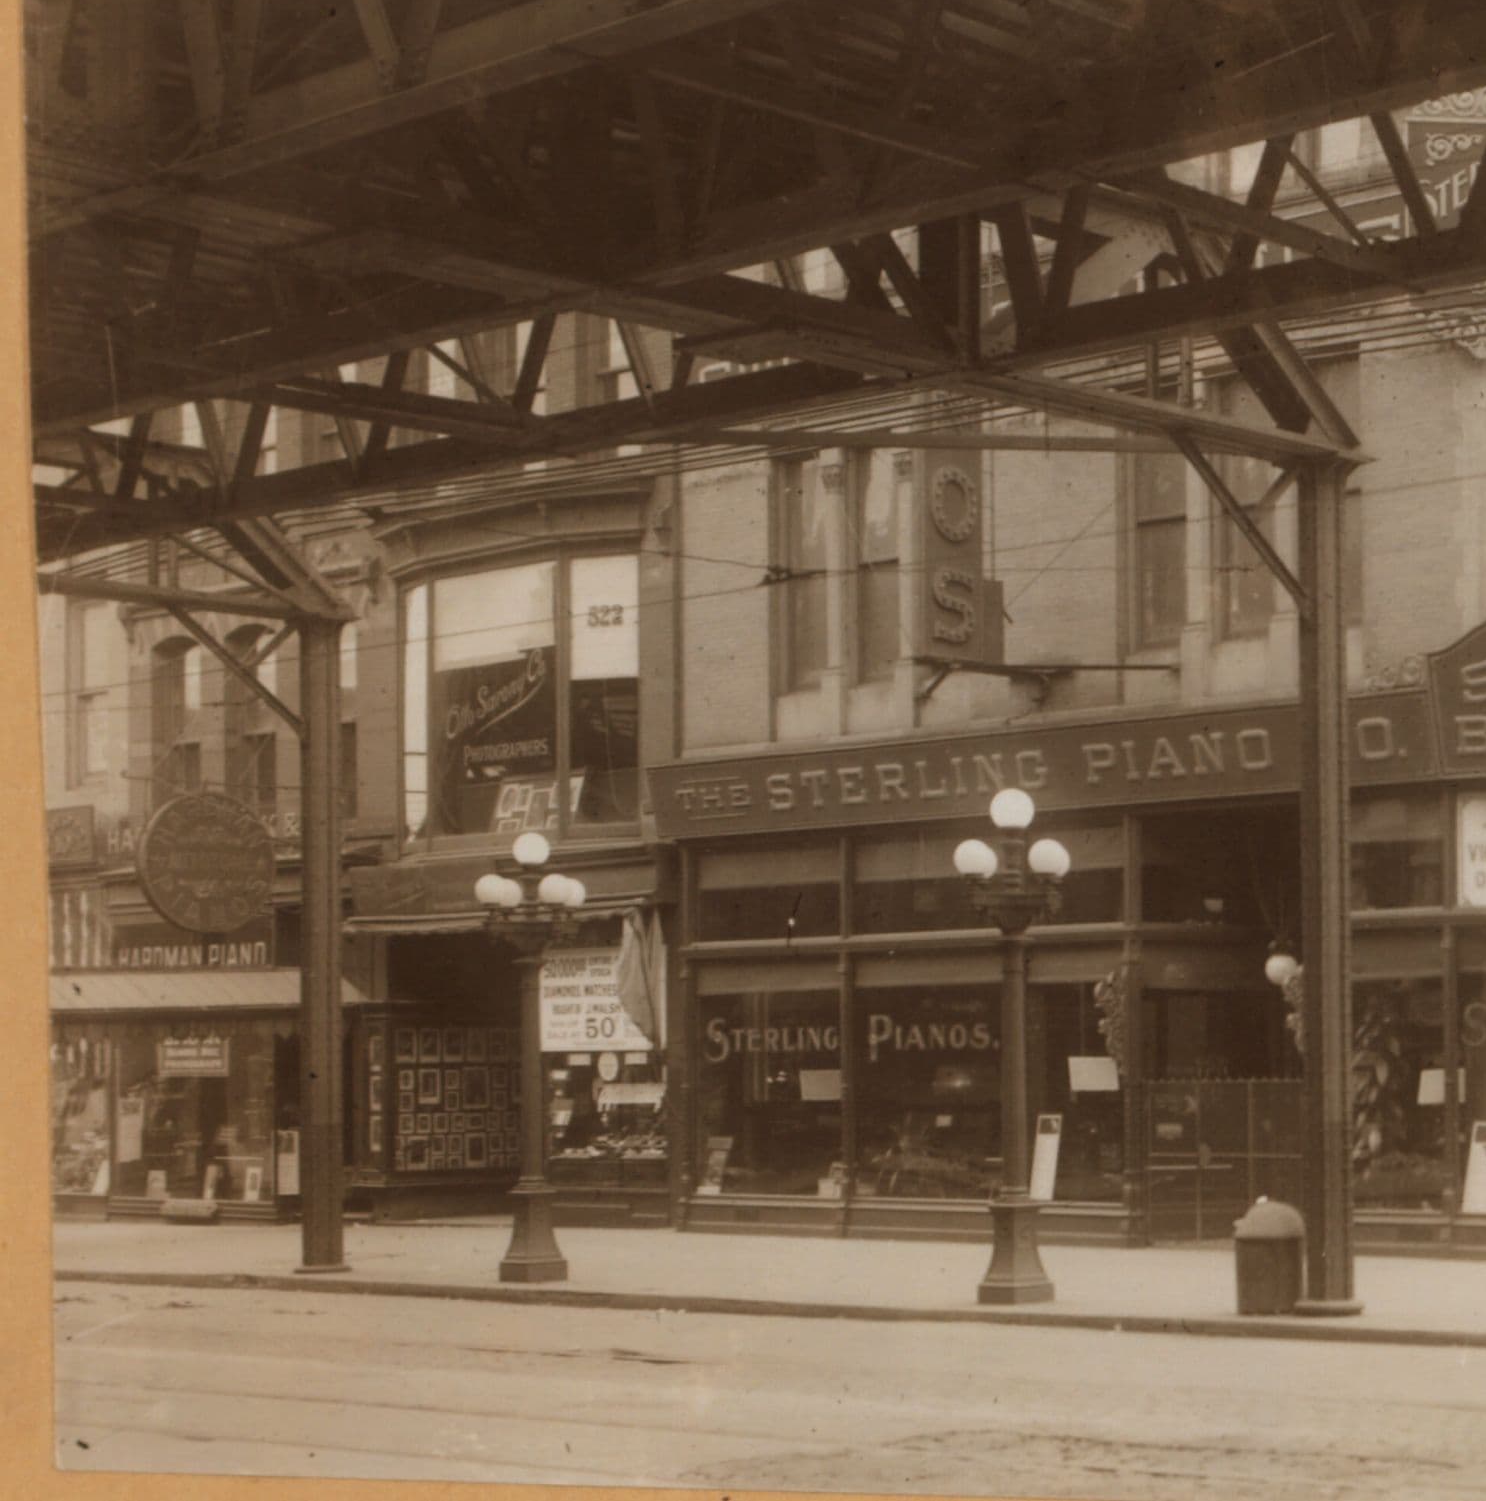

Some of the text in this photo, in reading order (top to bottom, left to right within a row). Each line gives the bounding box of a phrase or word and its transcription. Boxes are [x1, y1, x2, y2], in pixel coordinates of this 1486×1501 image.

[587, 603, 624, 628] 522
[674, 717, 1408, 811] THE STERLING PIANO O.
[705, 1014, 999, 1062] STERLING PIANOS.
